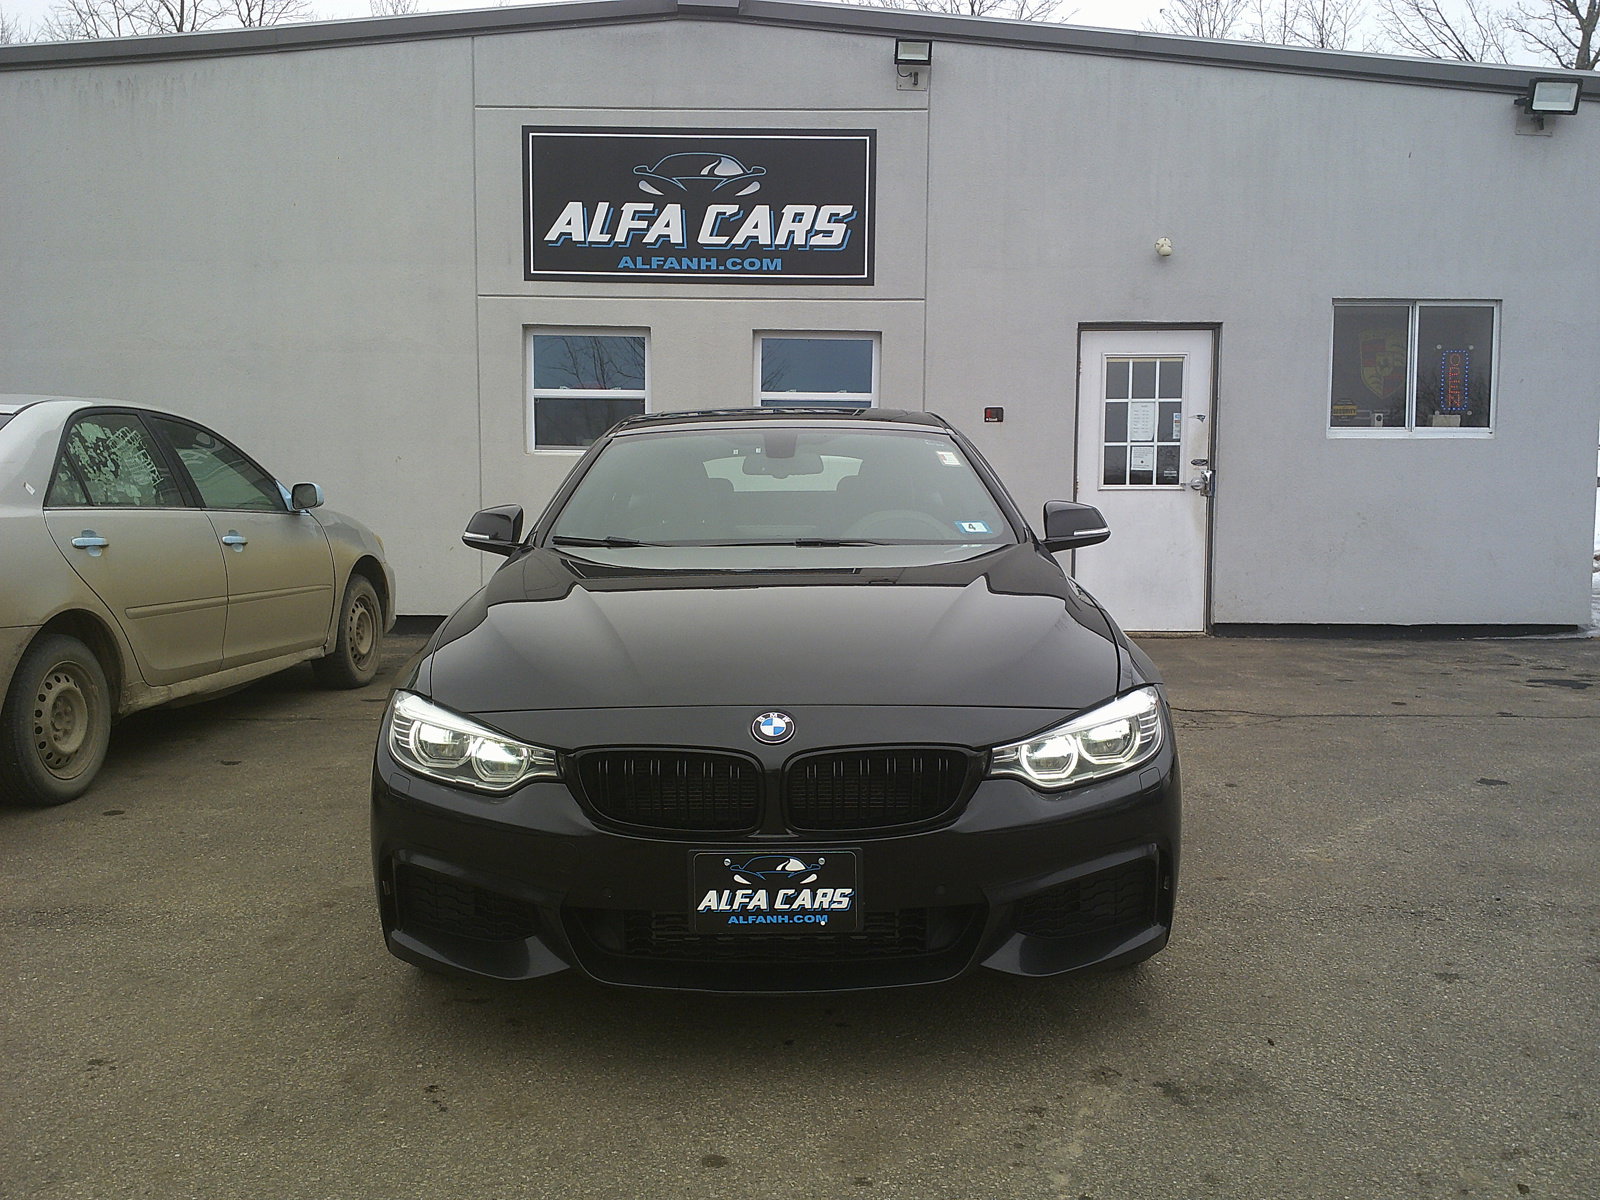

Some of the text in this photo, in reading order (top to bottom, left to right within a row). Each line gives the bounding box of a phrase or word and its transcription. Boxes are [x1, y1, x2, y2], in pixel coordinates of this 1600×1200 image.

[544, 201, 857, 251] ALFA CARS
[617, 256, 783, 271] ALFANH.COM
[696, 888, 855, 913] ALFA CARS
[727, 914, 828, 925] ALFANH.COM
